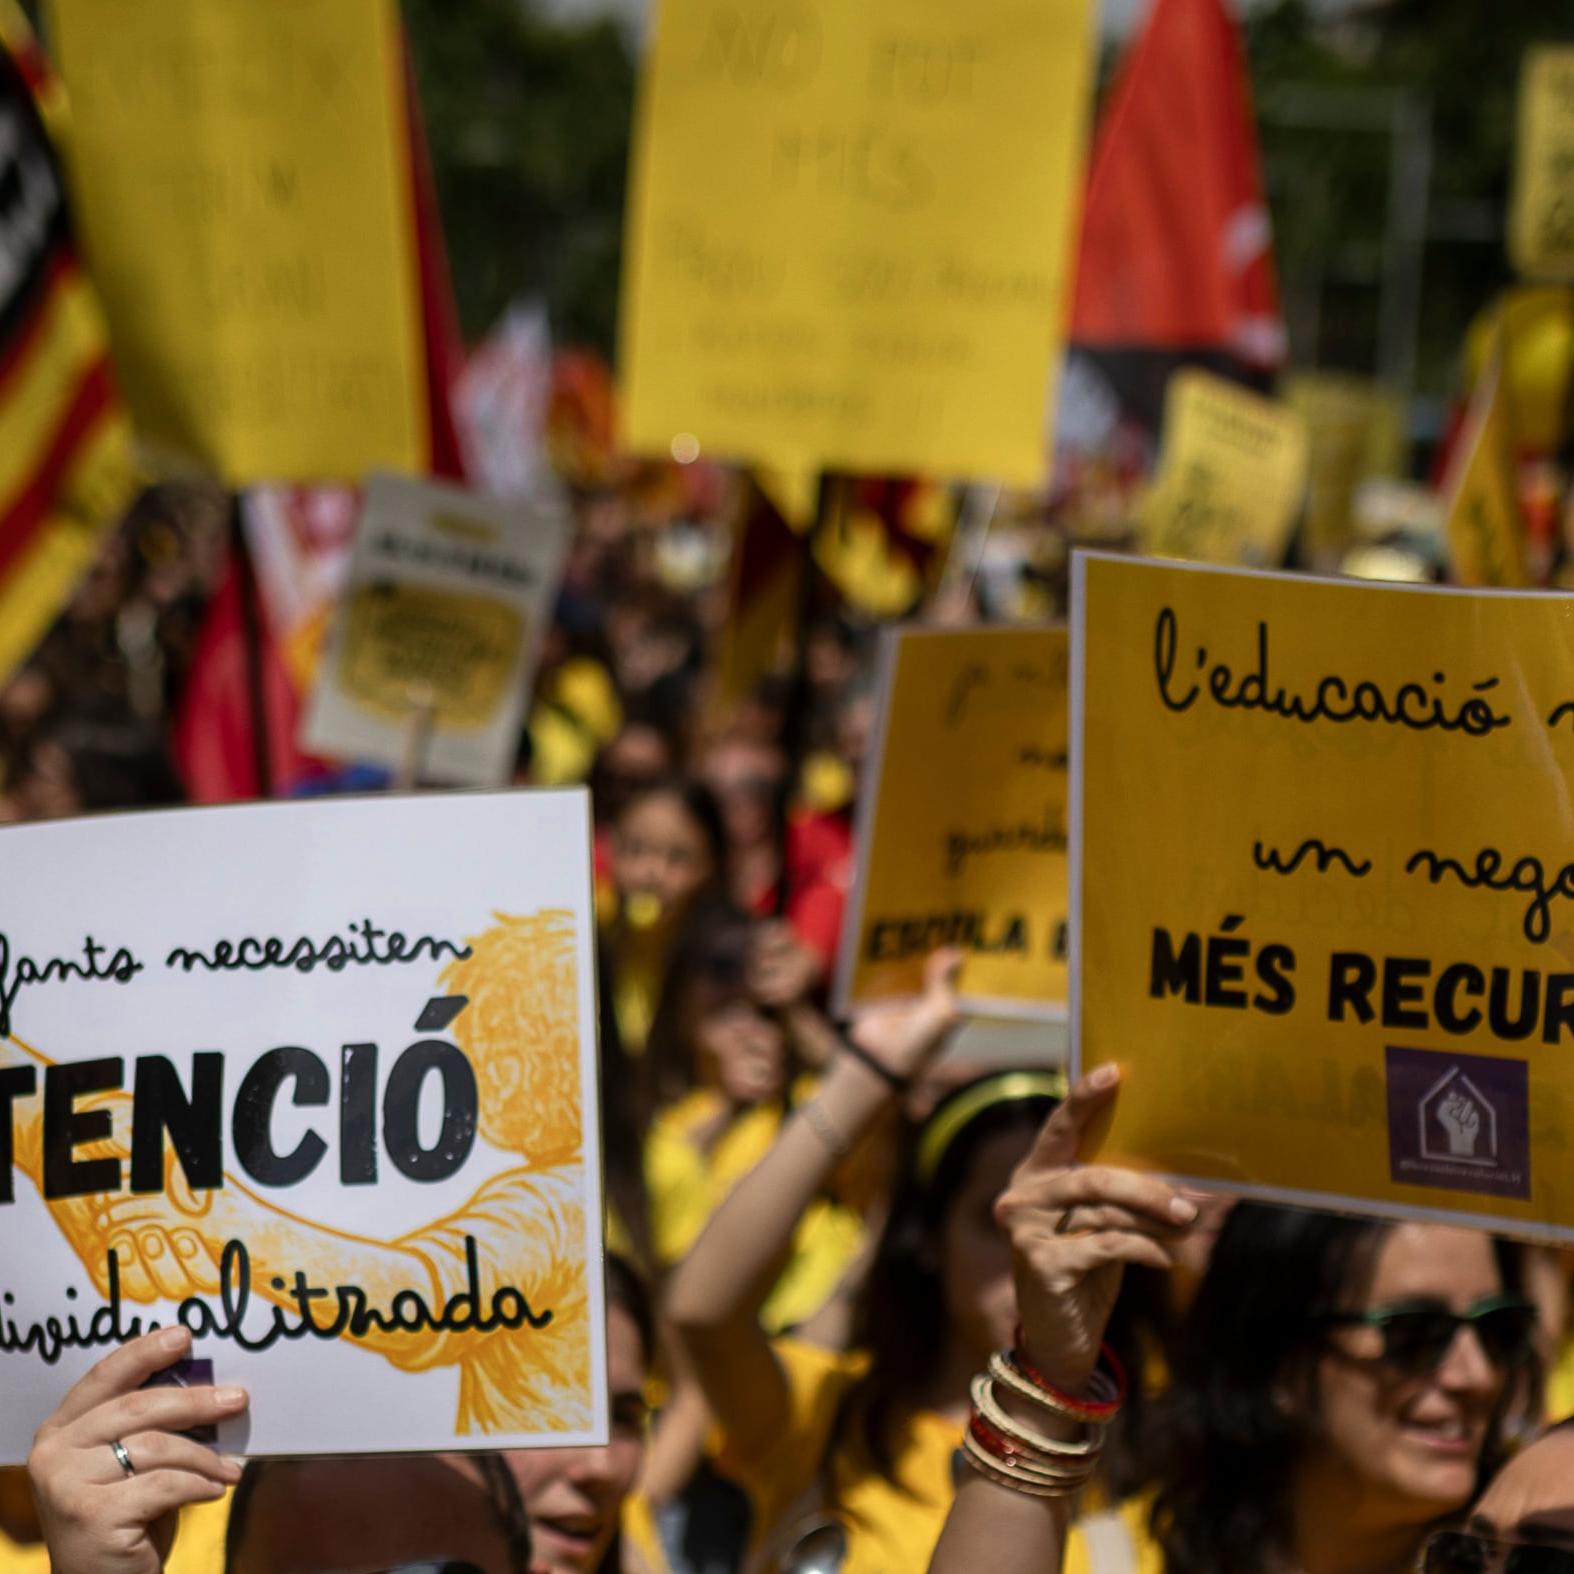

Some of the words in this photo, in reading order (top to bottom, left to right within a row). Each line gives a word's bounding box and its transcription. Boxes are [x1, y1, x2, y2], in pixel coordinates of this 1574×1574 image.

[1152, 606, 1510, 739] l'educació
[1253, 837, 1372, 880] un
[166, 917, 473, 974] necessiten
[1149, 914, 1297, 1016] MÉS
